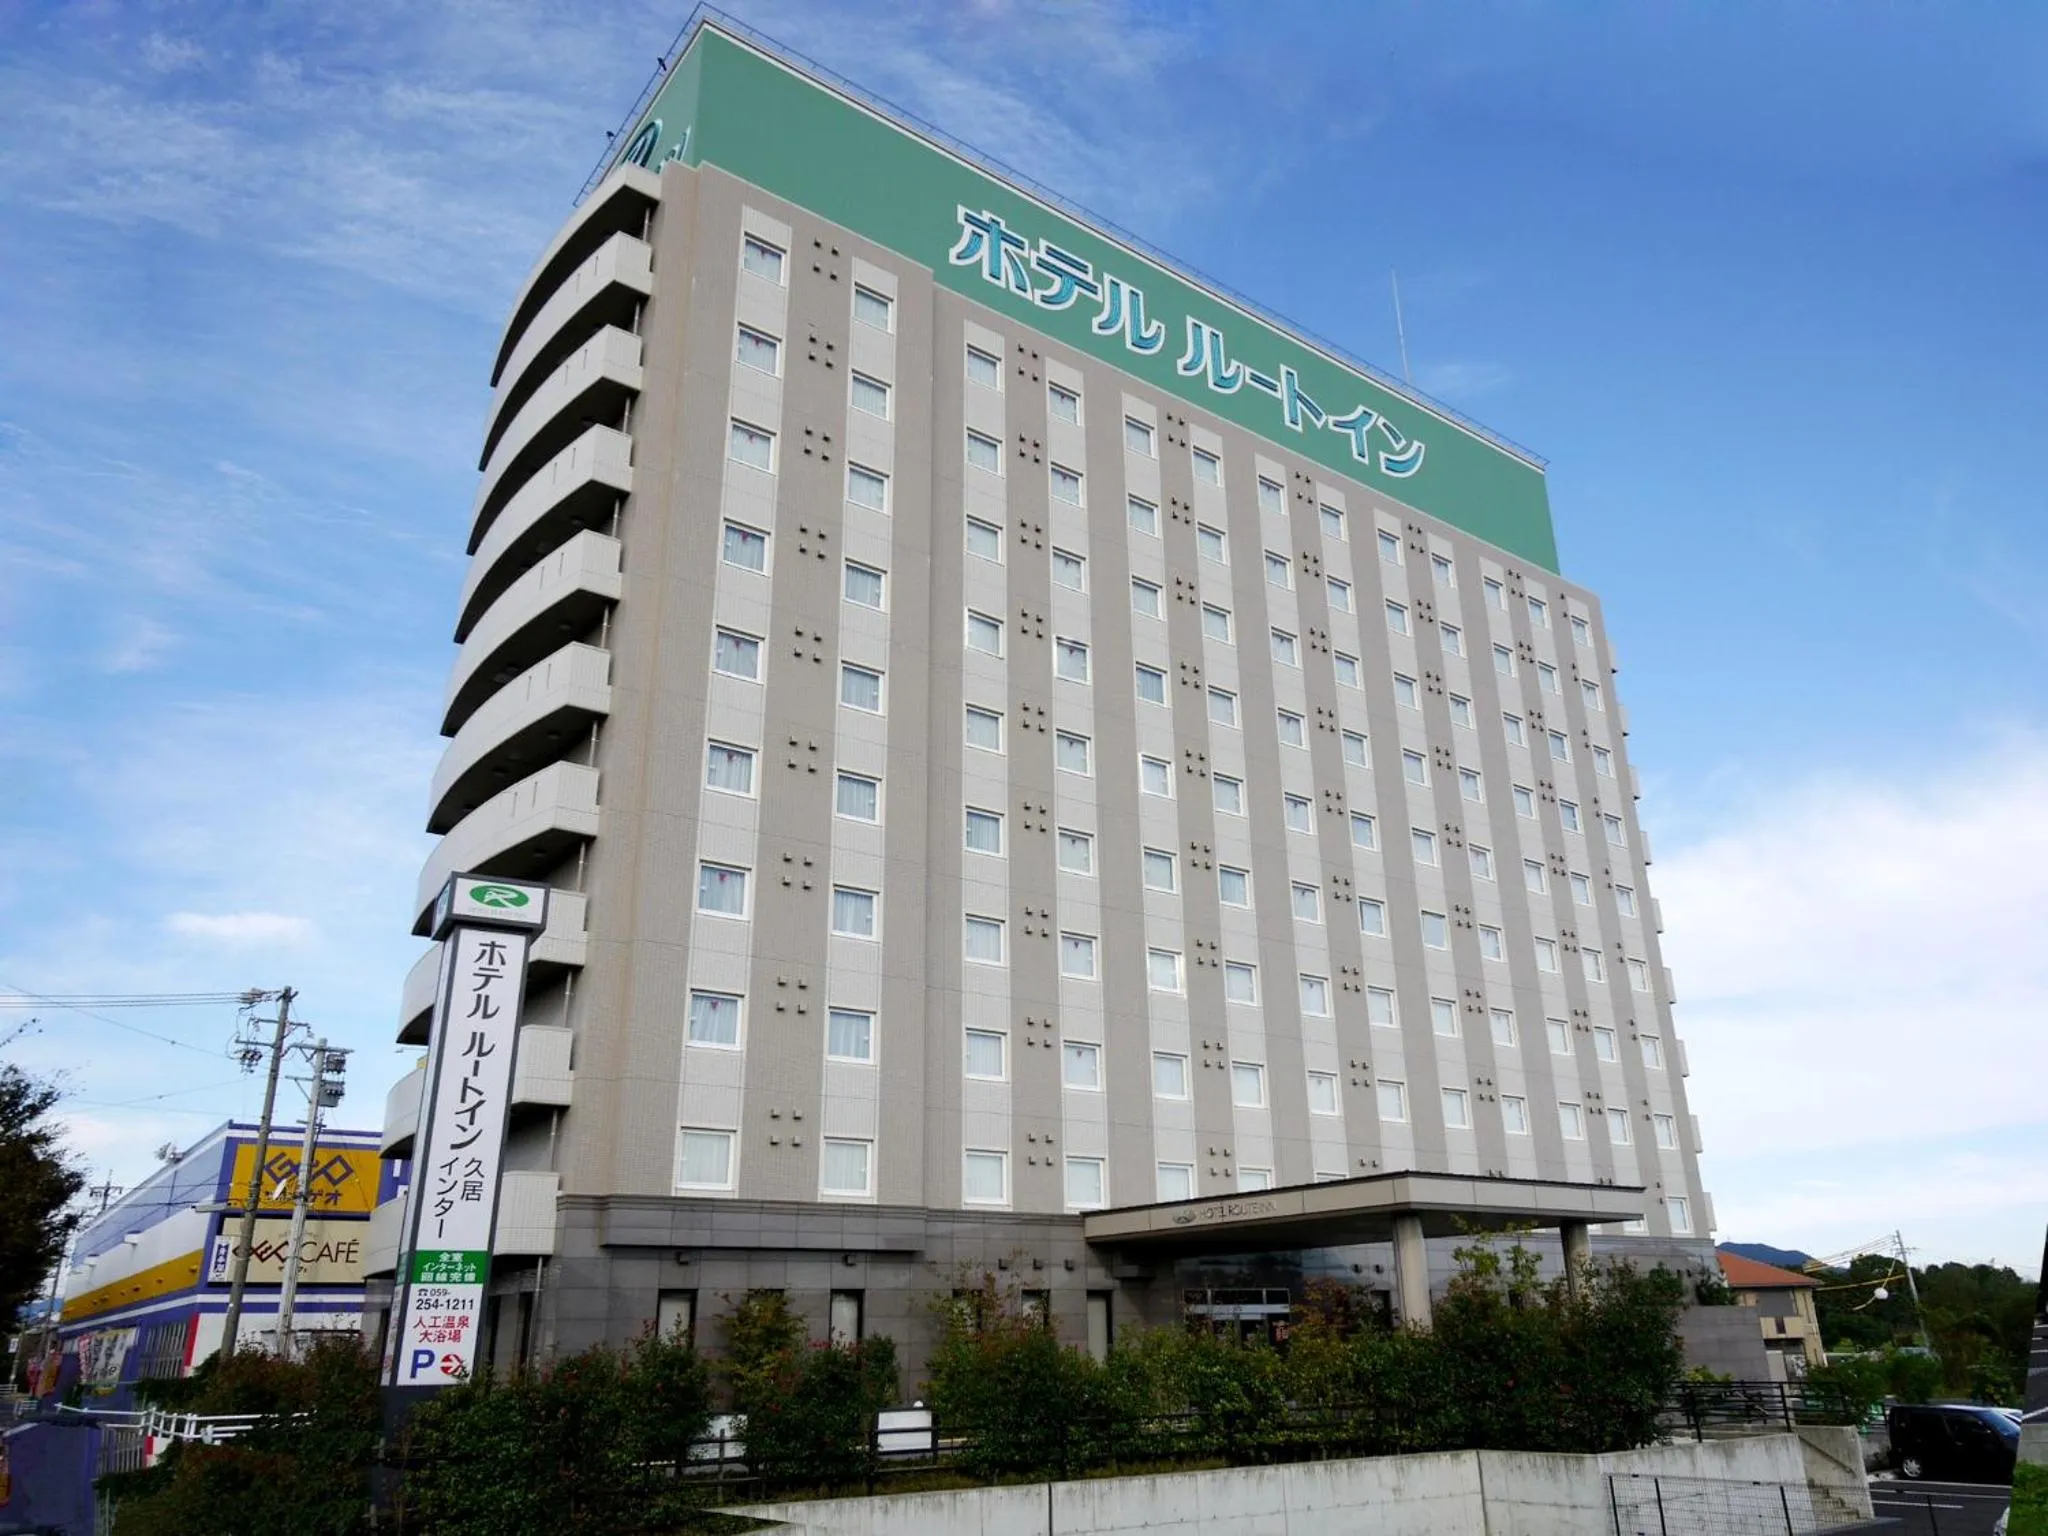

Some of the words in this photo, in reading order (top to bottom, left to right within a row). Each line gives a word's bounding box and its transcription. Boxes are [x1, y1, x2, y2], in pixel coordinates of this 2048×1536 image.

[948, 203, 1165, 356] ホテル
[1177, 314, 1427, 478] ルートイン
[466, 940, 508, 1020] ホテル
[449, 1031, 497, 1150] ルートイン
[460, 1157, 485, 1202] 久居
[433, 1156, 460, 1240] インター
[299, 1238, 360, 1264] CAFÉ
[423, 1262, 477, 1272] インターネット
[416, 1299, 474, 1311] 254-1211
[430, 1289, 451, 1297] 059-
[413, 1315, 470, 1330] 人工温泉
[418, 1330, 462, 1344] 大浴場
[410, 1348, 436, 1380] P
